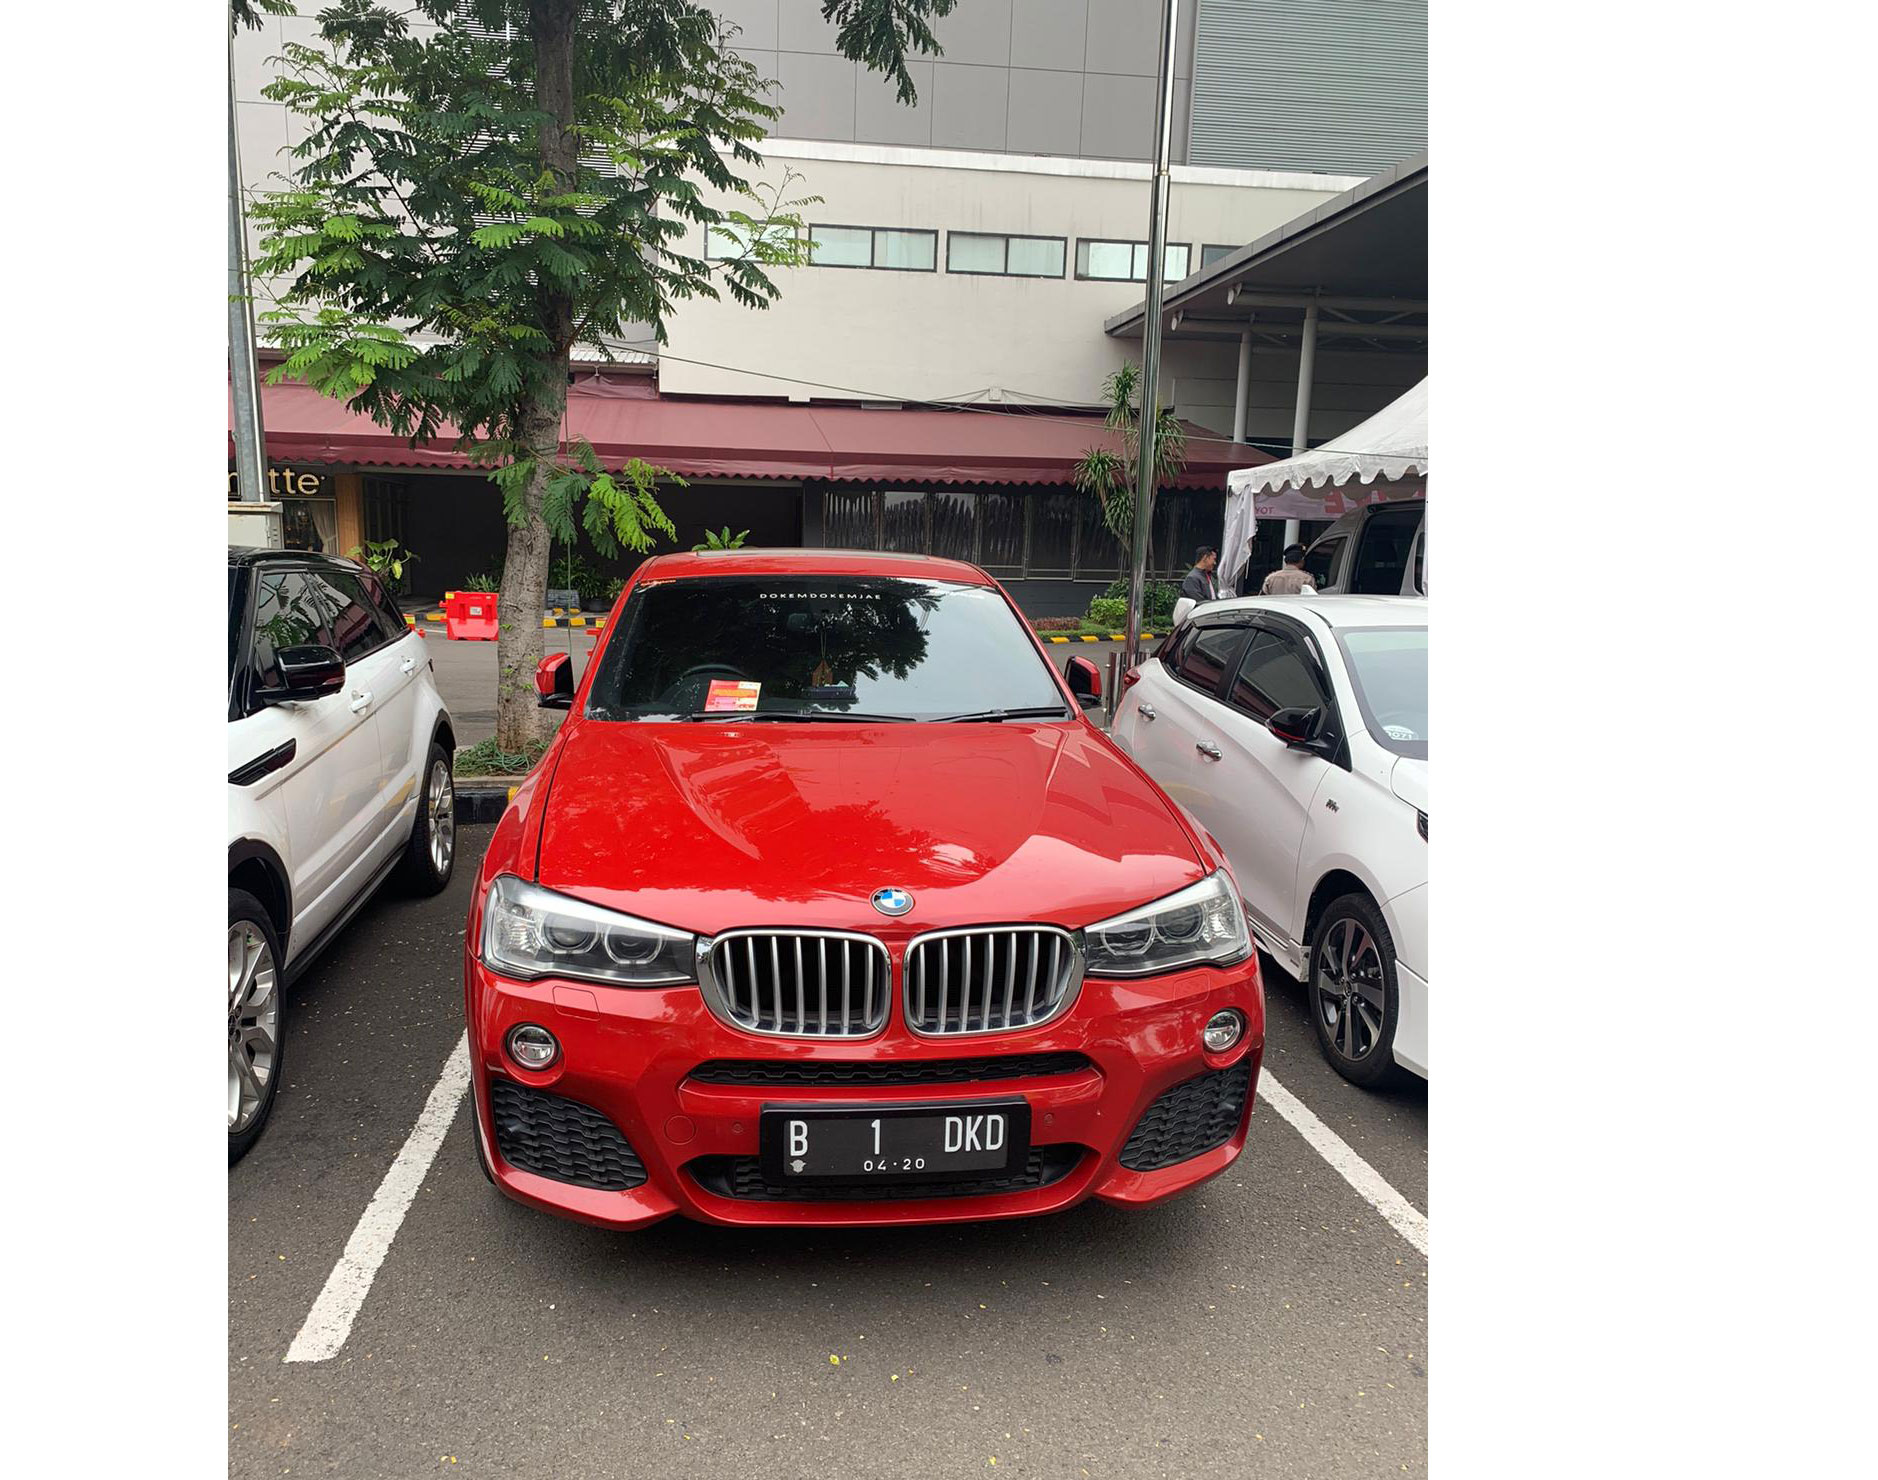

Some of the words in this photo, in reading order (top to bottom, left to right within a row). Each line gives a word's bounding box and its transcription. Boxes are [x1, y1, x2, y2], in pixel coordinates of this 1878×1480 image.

[789, 1120, 809, 1157] B
[871, 1118, 881, 1155] 1
[944, 1114, 1005, 1153] DKD
